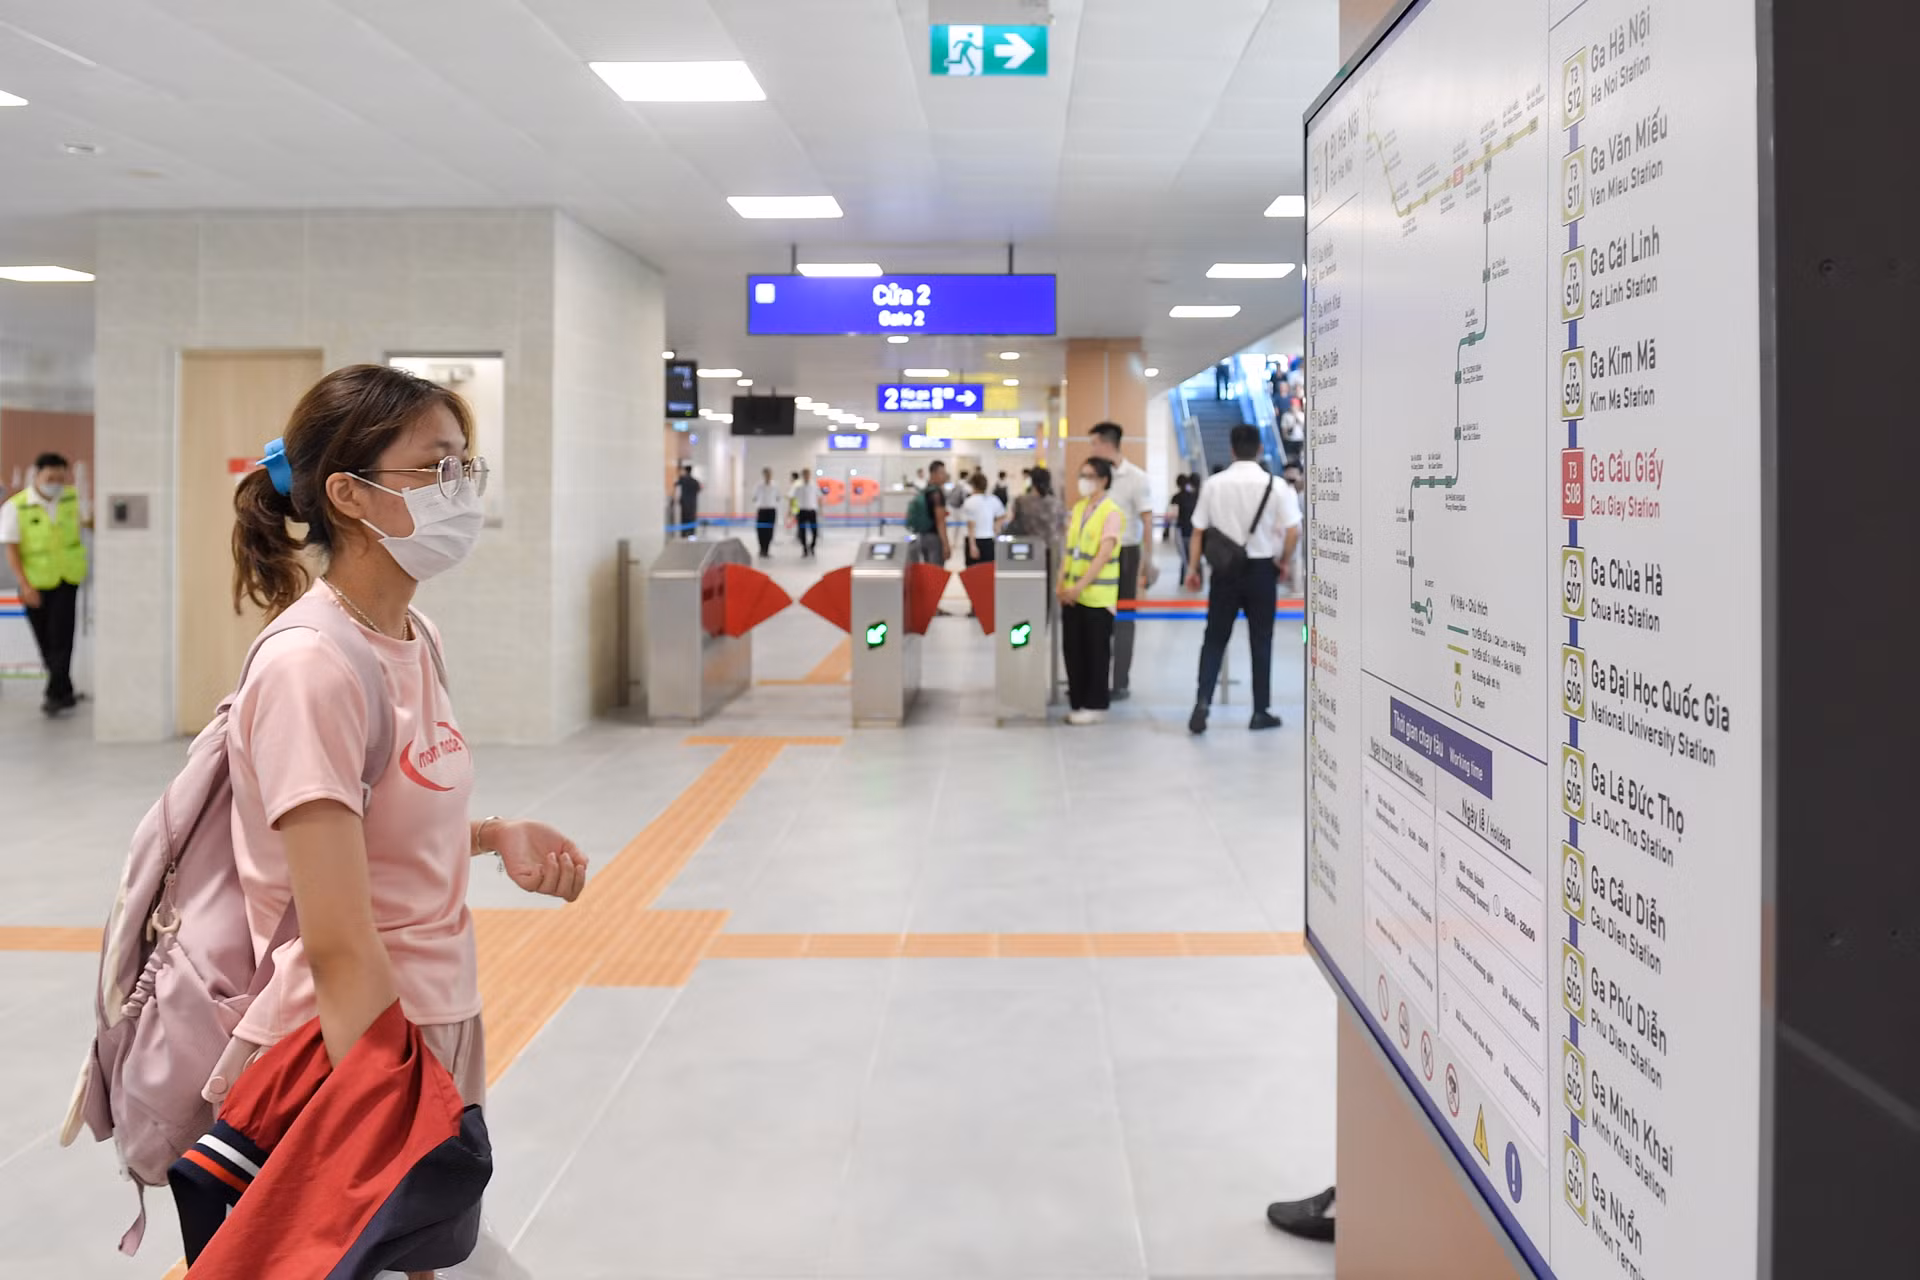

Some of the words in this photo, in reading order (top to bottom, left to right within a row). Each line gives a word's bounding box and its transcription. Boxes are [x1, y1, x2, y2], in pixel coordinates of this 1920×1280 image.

[1590, 43, 1605, 73] Ga
[1609, 24, 1625, 62] Hà
[1629, 7, 1650, 48] Nội
[1569, 65, 1578, 84] T3
[1591, 84, 1602, 106] Ha
[1603, 70, 1617, 97] Noi
[1619, 55, 1650, 88] Station
[1567, 85, 1581, 114] S12
[1590, 146, 1605, 175] Ga
[1608, 132, 1631, 165] Văn
[1635, 106, 1667, 152] Miếu
[1569, 162, 1578, 182] T3
[1590, 186, 1605, 207] Van
[1608, 176, 1628, 199] Mieu
[1630, 160, 1662, 189] Station
[1567, 183, 1580, 209] S11
[1590, 247, 1605, 276] Ga
[1608, 237, 1627, 270] Cát
[1631, 225, 1659, 263] Linh
[1568, 262, 1577, 281] T3
[916, 284, 931, 306] 2
[1566, 281, 1580, 307] S10
[1590, 289, 1603, 310] Cat
[1605, 282, 1623, 306] Linh
[1626, 274, 1657, 300] Station
[913, 310, 925, 326] 2
[1568, 361, 1577, 381] T3
[1590, 350, 1604, 379] Ga
[1608, 345, 1632, 376] Kim
[1637, 338, 1656, 371] Mã
[884, 387, 899, 410] 2
[1564, 381, 1580, 406] S09
[1590, 391, 1606, 412] Kim
[1608, 389, 1621, 409] Ma
[1623, 385, 1654, 408] Station
[1567, 461, 1577, 480] T3
[1590, 453, 1605, 482] Ga
[1635, 447, 1663, 490] Giấy
[1564, 482, 1581, 505] S08
[1590, 494, 1605, 515] Cau
[1607, 495, 1626, 521] Giay
[1628, 495, 1660, 518] Station
[1568, 558, 1577, 579] T3
[1590, 556, 1605, 586] Ga
[1609, 558, 1640, 592] Chùa
[1645, 563, 1662, 596] Hà
[1565, 580, 1581, 604] S07
[1591, 597, 1611, 621] Chua
[1613, 602, 1625, 624] Ha
[1627, 604, 1659, 631] Station
[1569, 657, 1578, 678] T3
[1565, 679, 1581, 705] S06
[1591, 659, 1606, 691] Ga
[1609, 664, 1629, 704] Đại
[1633, 671, 1658, 713] Học
[1704, 692, 1729, 732] Gia
[1591, 700, 1625, 732] National
[1627, 713, 1675, 757] University
[1678, 731, 1715, 765] Station
[1449, 747, 1470, 777] Working
[1470, 760, 1483, 781] time
[1569, 757, 1578, 779] T3
[1565, 778, 1581, 807] S05
[1591, 762, 1606, 796] Ga
[1609, 770, 1624, 805] Lê
[1628, 779, 1654, 820] Đức
[1657, 792, 1684, 842] Thọ
[1462, 799, 1478, 830] Ngày
[1490, 827, 1511, 851] Holidays
[1591, 802, 1601, 826] Le
[1603, 809, 1619, 837] Duc
[1621, 818, 1637, 847] Tho
[1640, 829, 1673, 866] Station
[1569, 856, 1578, 879] T3
[1591, 864, 1605, 900] Ga
[1565, 876, 1581, 906] S04
[1590, 905, 1605, 933] Cau
[1608, 917, 1626, 949] Dien
[1629, 933, 1660, 974] Station
[1569, 955, 1578, 979] T3
[1565, 975, 1581, 1007] S03
[1591, 966, 1605, 1003] Ga
[1609, 980, 1632, 1026] Phú
[1591, 1007, 1606, 1039] Phu
[1609, 1023, 1627, 1056] Dien
[1630, 1043, 1661, 1088] Station
[1570, 1053, 1579, 1077] T3
[1566, 1072, 1582, 1109] S02
[1591, 1069, 1606, 1108] Ga
[1609, 1086, 1638, 1141] Minh
[1643, 1119, 1672, 1176] Khai
[1570, 1149, 1579, 1174] T3
[1591, 1108, 1611, 1145] Minh
[1613, 1131, 1632, 1168] Khai
[1634, 1154, 1666, 1204] Station
[1567, 1168, 1582, 1206] S01
[1591, 1171, 1606, 1211] Ga
[1592, 1211, 1613, 1252] Nhon
